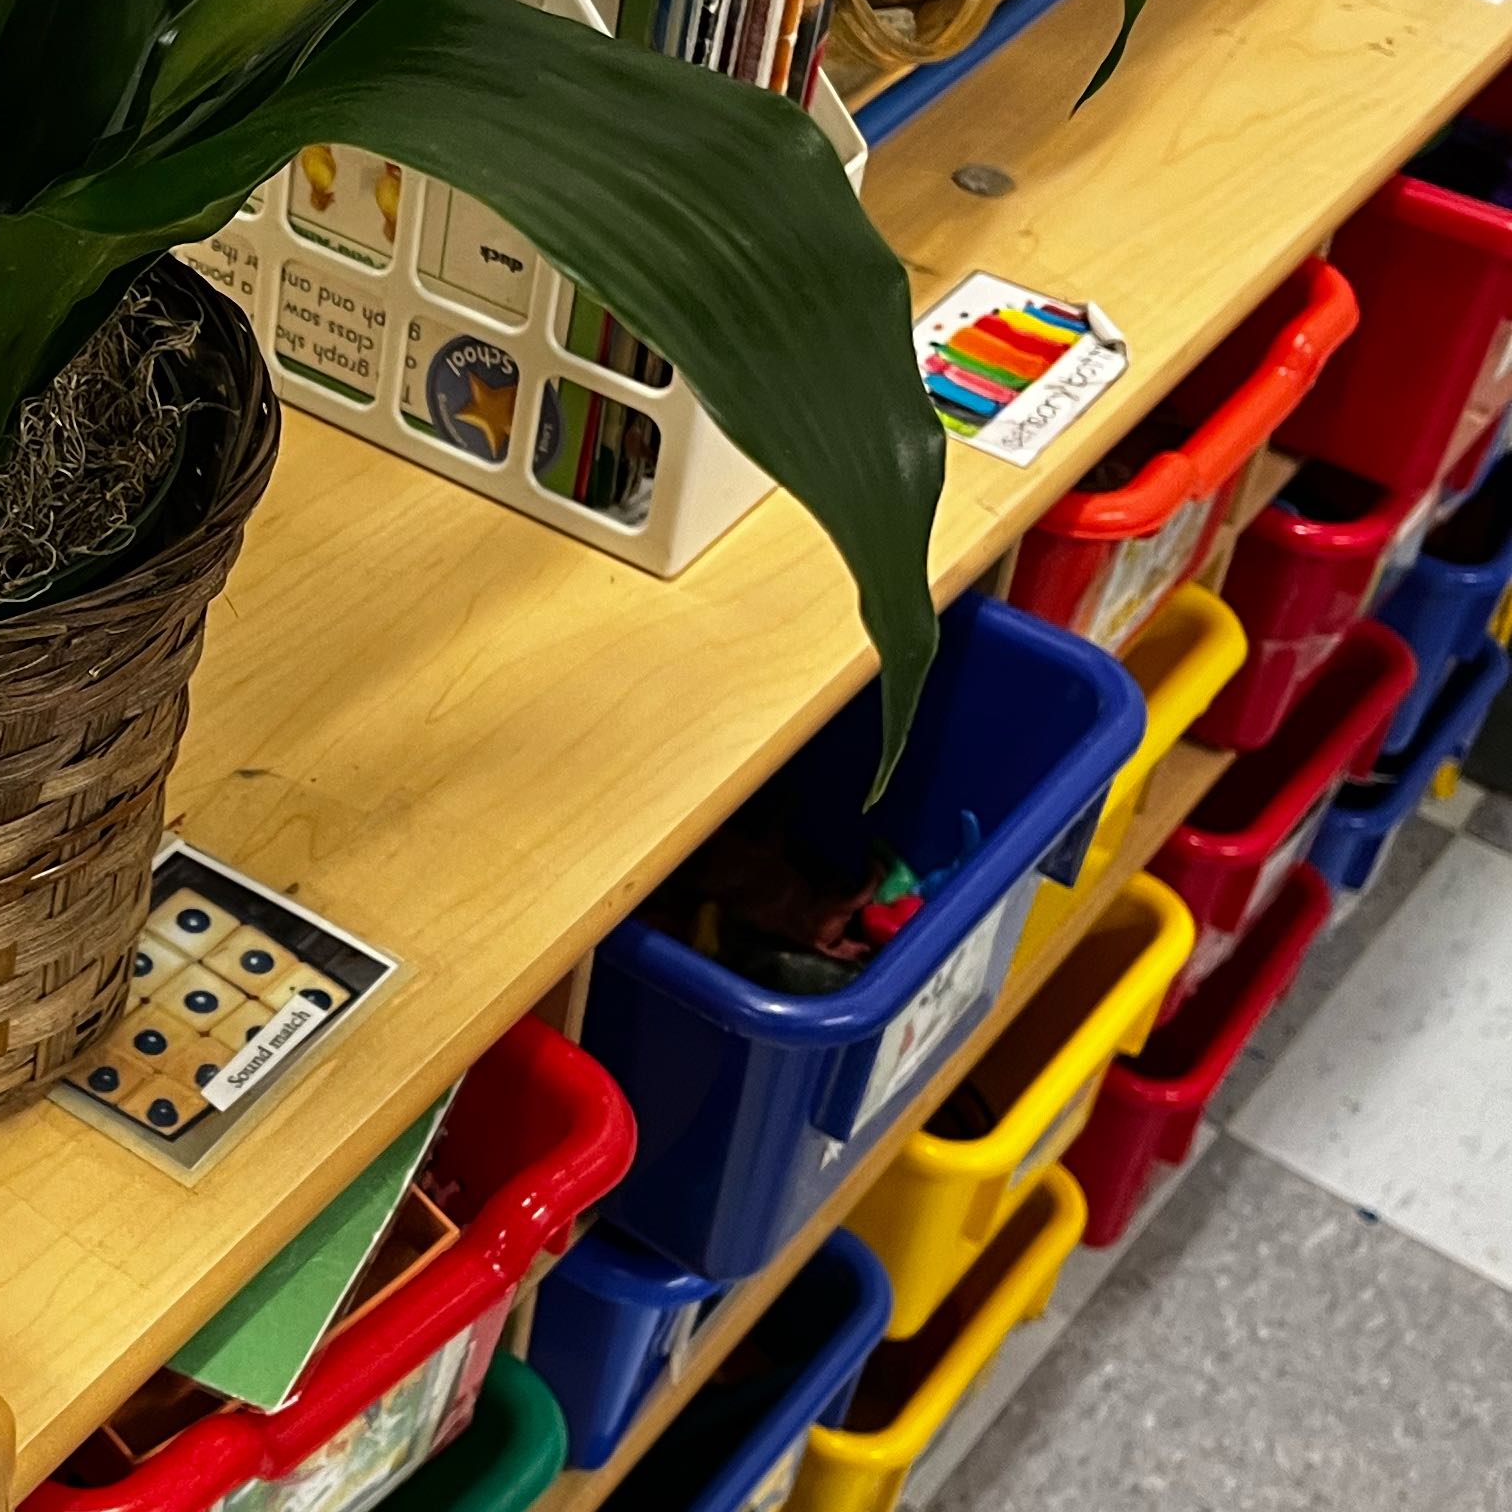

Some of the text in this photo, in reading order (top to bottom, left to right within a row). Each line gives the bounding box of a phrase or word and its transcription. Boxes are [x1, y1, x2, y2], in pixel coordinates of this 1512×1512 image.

[211, 238, 239, 266] the
[317, 287, 355, 313] and
[480, 245, 524, 276] duck
[241, 280, 253, 296] a
[284, 301, 321, 326] saw
[328, 320, 375, 354] class
[276, 324, 305, 351] sho
[313, 343, 370, 378] graph
[445, 344, 516, 378] School
[226, 1009, 311, 1089] Sound match
